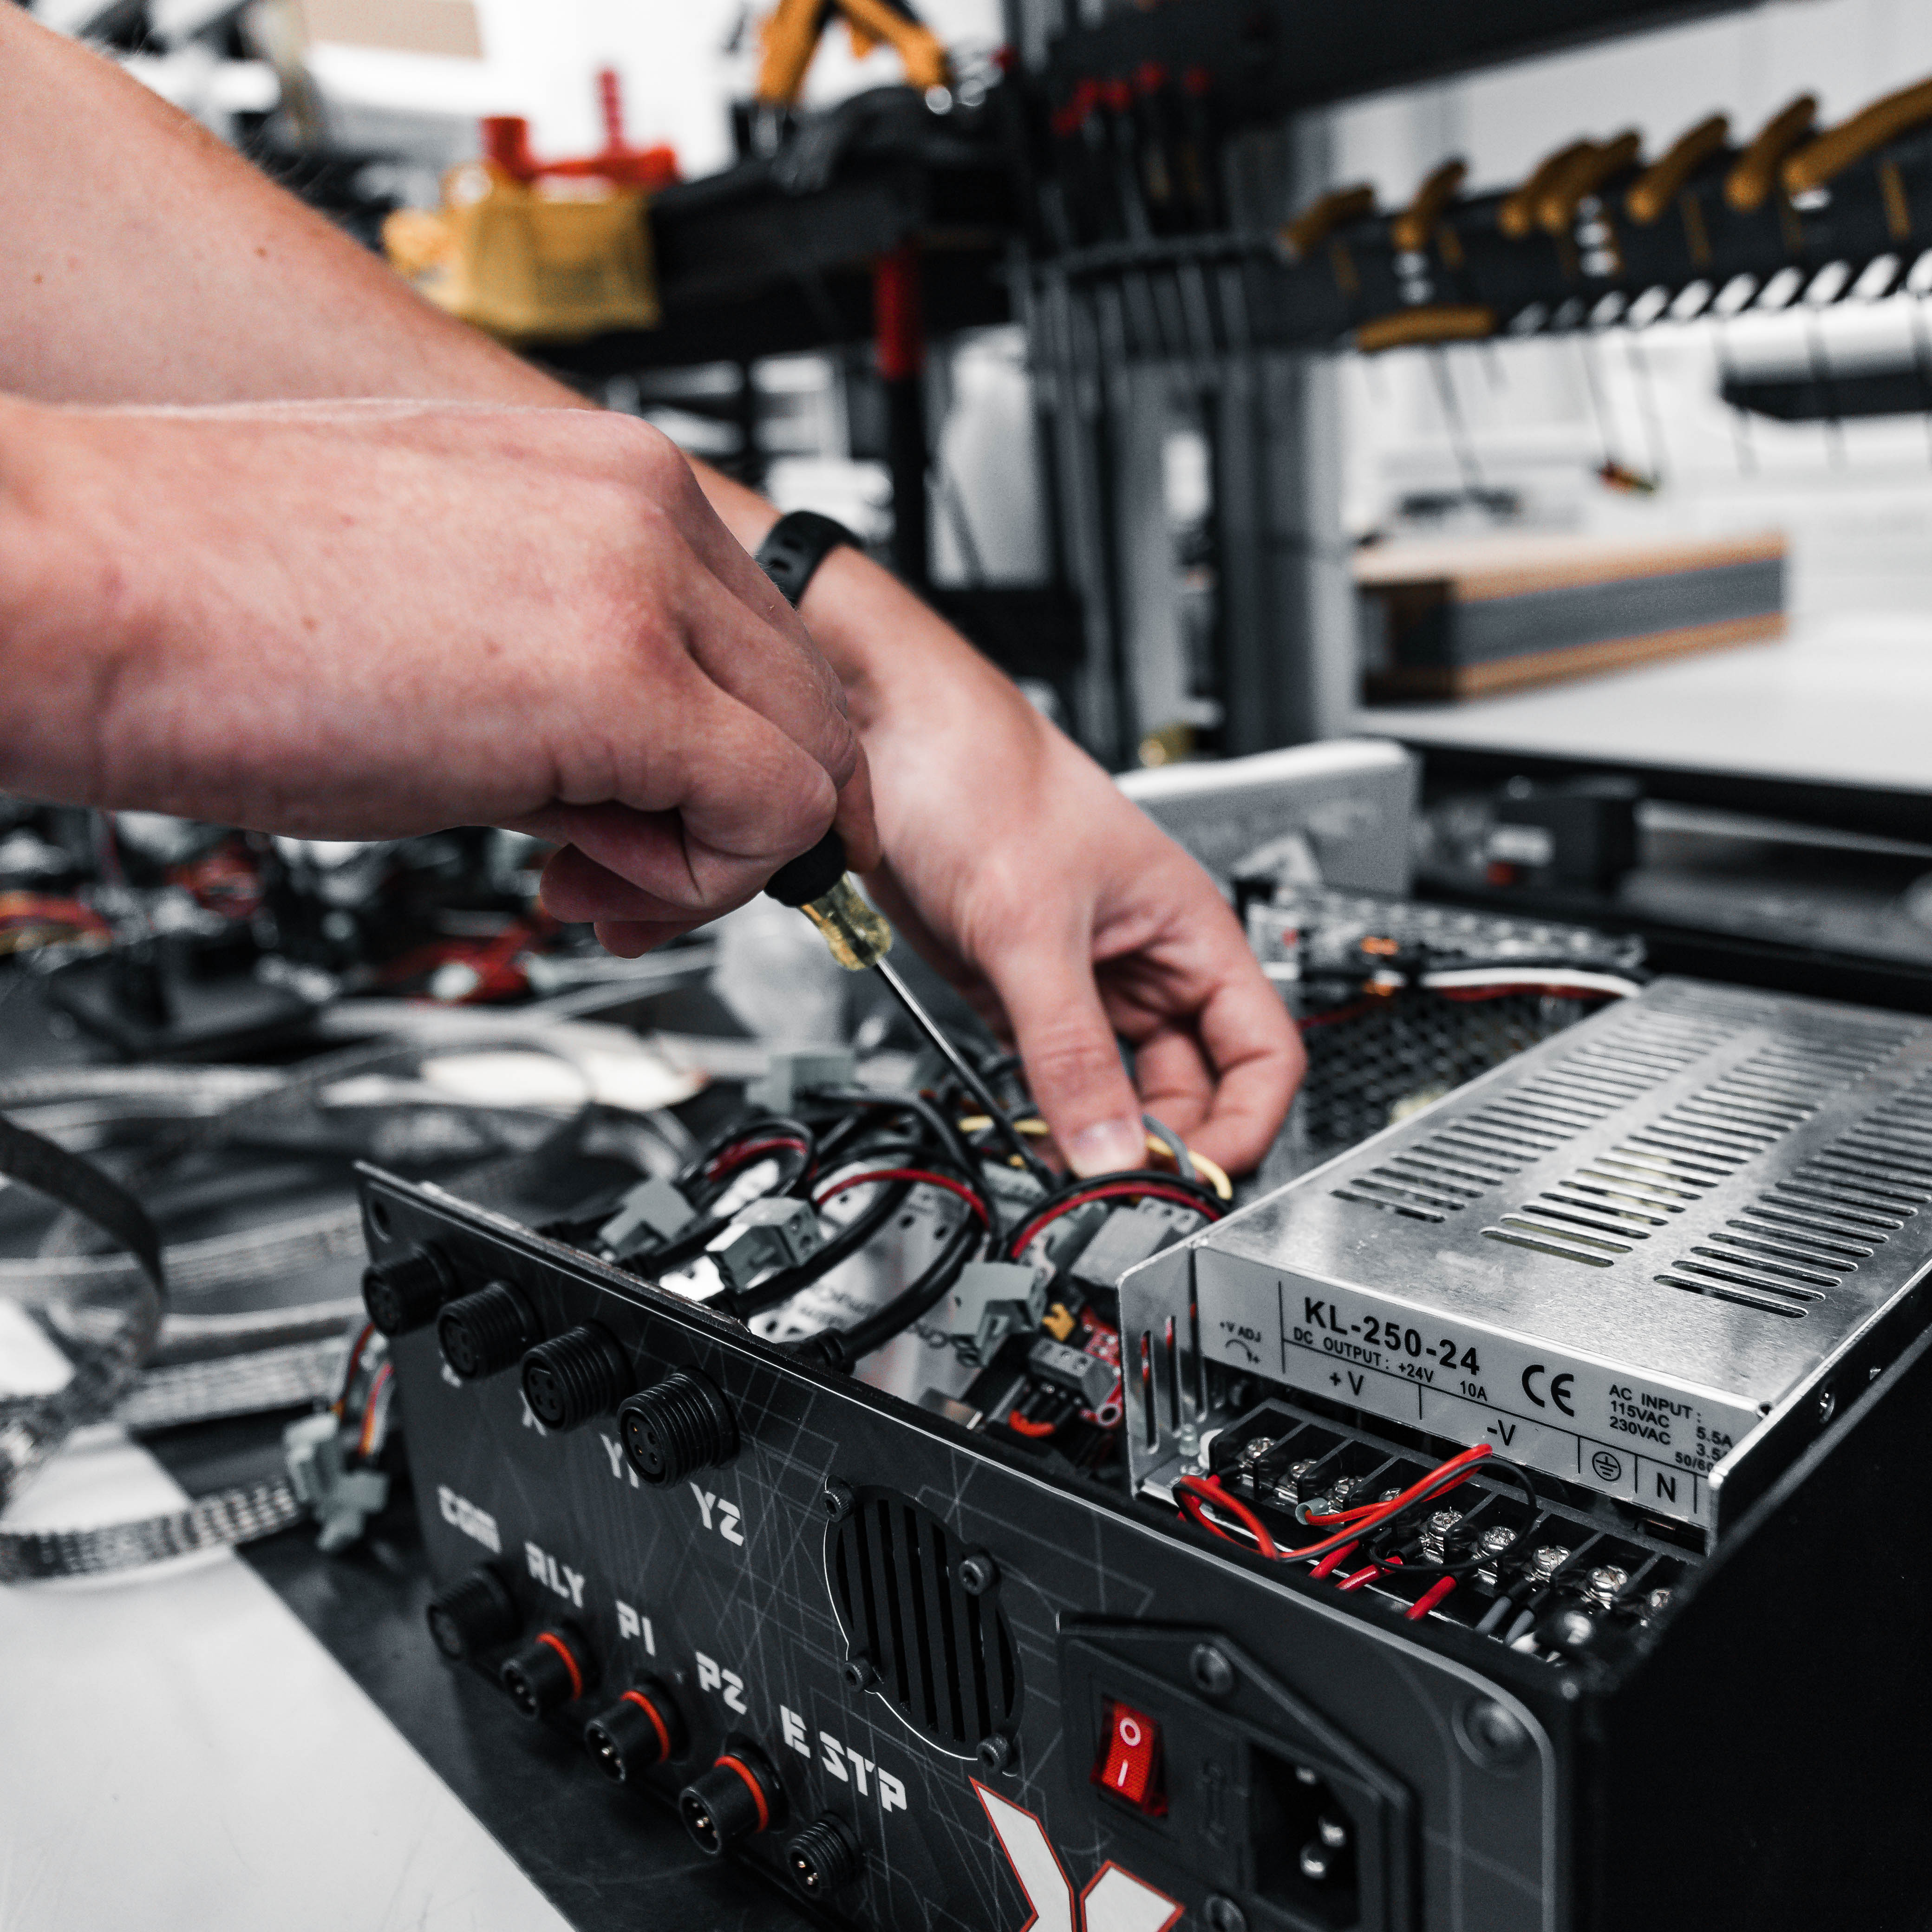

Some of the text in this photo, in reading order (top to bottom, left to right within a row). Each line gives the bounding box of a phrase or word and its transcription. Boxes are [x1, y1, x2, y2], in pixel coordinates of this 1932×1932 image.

[1294, 1327, 1313, 1345] DC
[1398, 1362, 1434, 1383] +24V
[1460, 1380, 1488, 1401] 10A
[1305, 1297, 1480, 1376] KL-250-24
[1609, 1384, 1633, 1401] AC
[1487, 1420, 1516, 1447] -V
[1610, 1416, 1671, 1445] 230VAC
[1611, 1400, 1734, 1448] 115VAC 5.5A
[689, 1482, 744, 1547] Y2
[1657, 1472, 1676, 1503] N
[696, 1651, 747, 1715] P2
[780, 1704, 907, 1811] E STP
